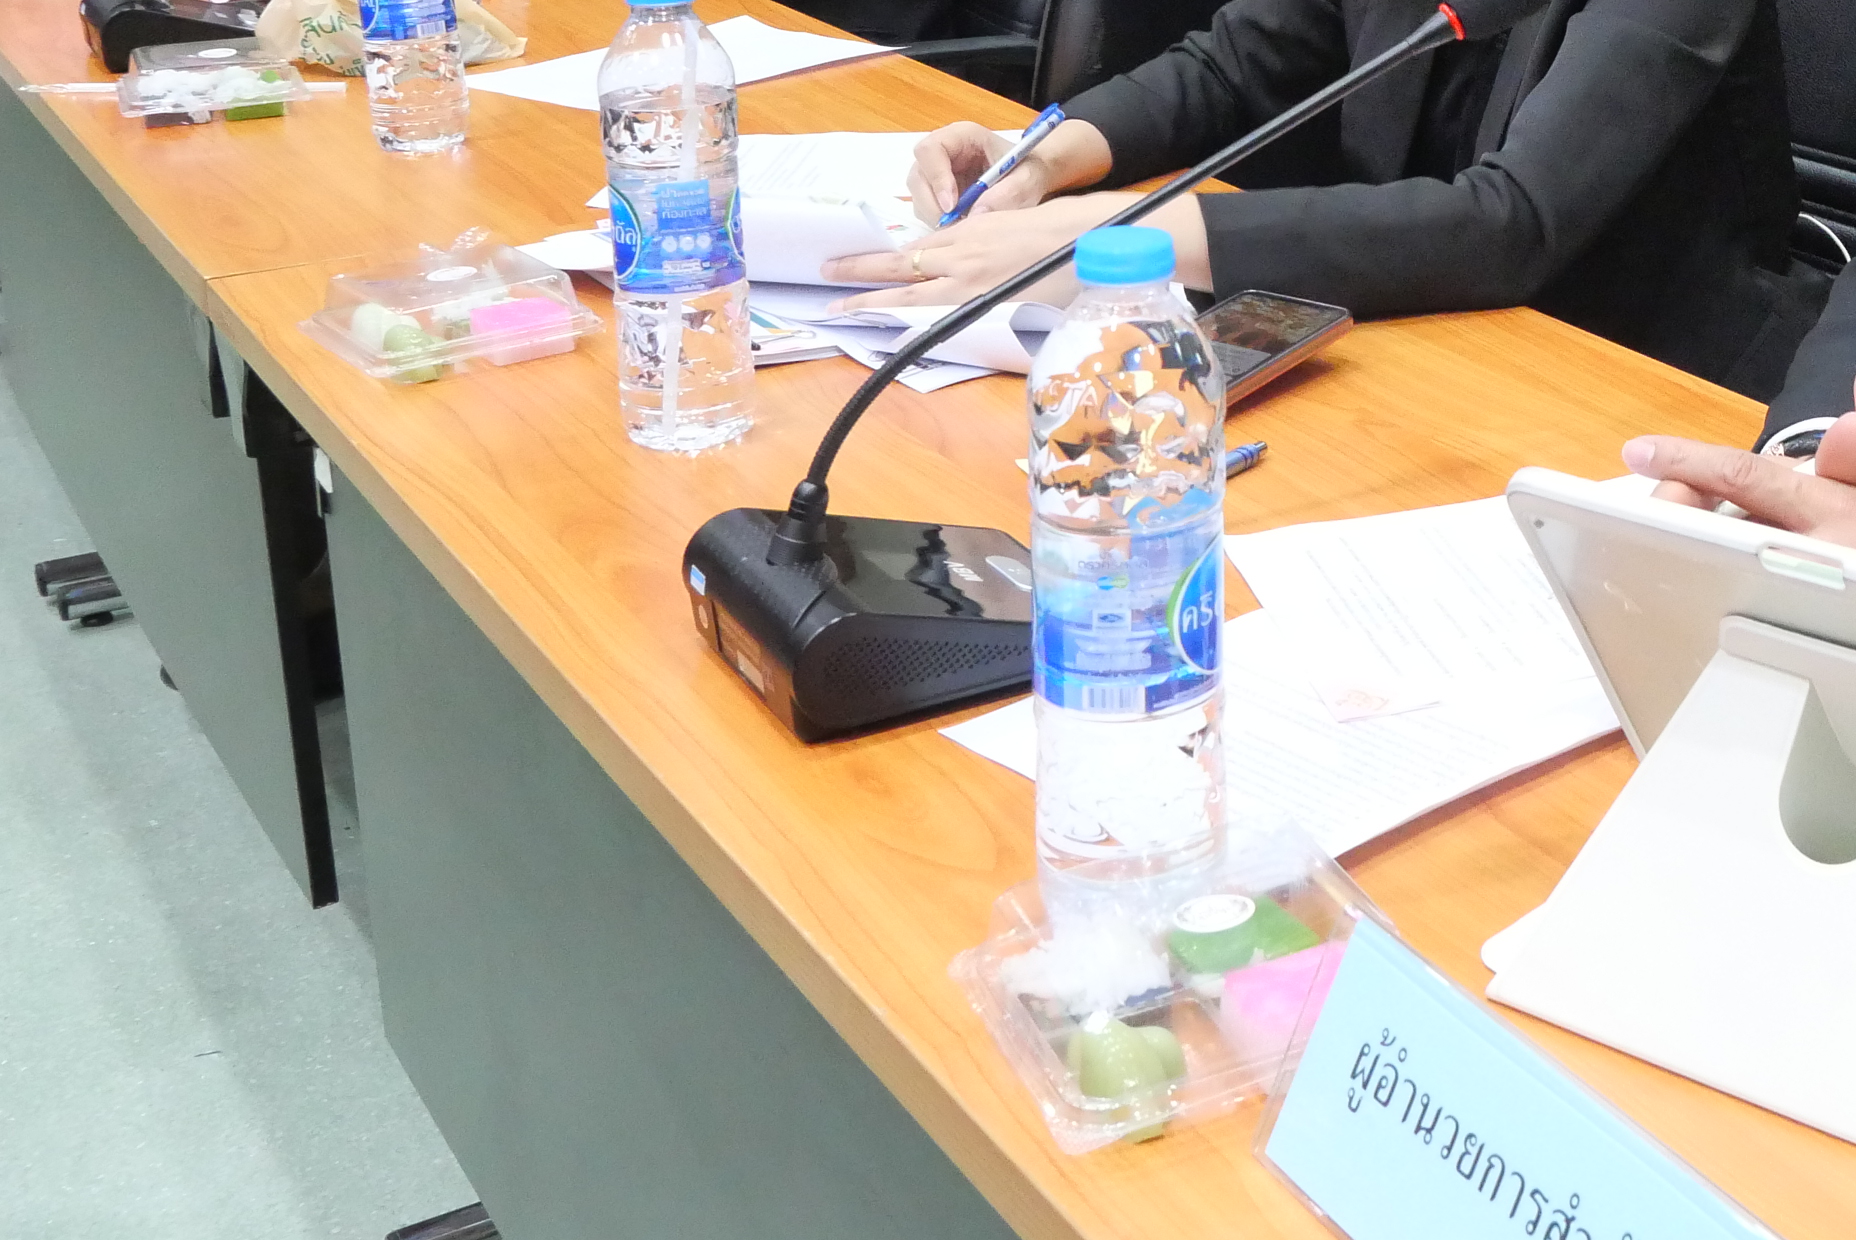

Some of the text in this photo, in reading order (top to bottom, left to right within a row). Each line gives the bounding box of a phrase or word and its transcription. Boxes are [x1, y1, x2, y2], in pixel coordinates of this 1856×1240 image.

[1347, 1027, 1633, 1240] ผู้อำนวยการสำ
